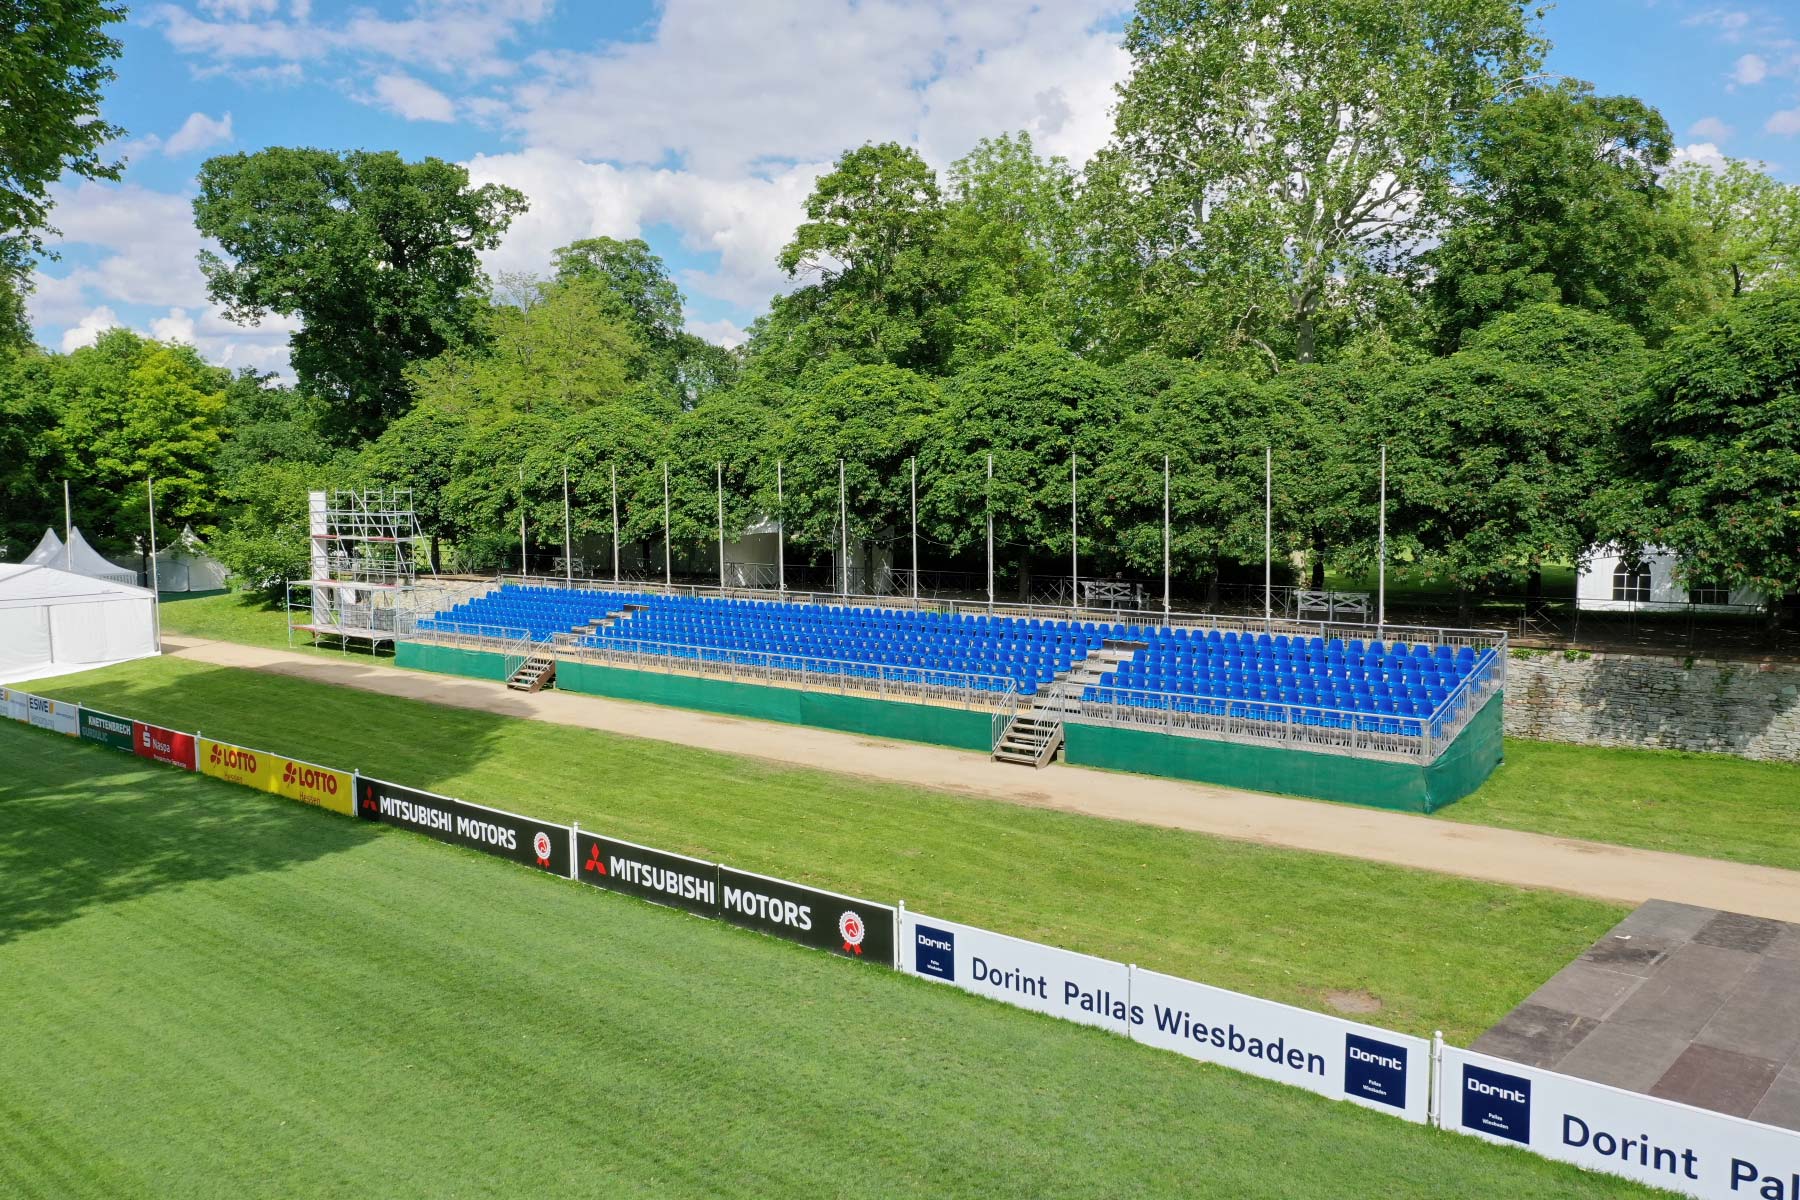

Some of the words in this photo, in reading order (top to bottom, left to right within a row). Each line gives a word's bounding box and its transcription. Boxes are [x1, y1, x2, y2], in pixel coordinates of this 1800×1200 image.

[30, 697, 49, 713] ESWE
[152, 737, 171, 754] Naspa
[223, 748, 257, 774] LOTTO
[299, 767, 338, 795] LOTTO
[379, 795, 452, 832] MITSUBISHI
[457, 815, 517, 850] MOTORS
[610, 855, 715, 905] MITSUBISHI
[724, 886, 812, 931] MOTORS
[918, 934, 952, 951] Dorint
[972, 956, 1047, 999] Dorint
[1064, 981, 1144, 1025] Pallas
[1154, 1004, 1325, 1076] Wiesbaden
[1349, 1046, 1402, 1071] Dorint
[1467, 1077, 1526, 1104] Dorint
[1562, 1113, 1698, 1180] Dorint
